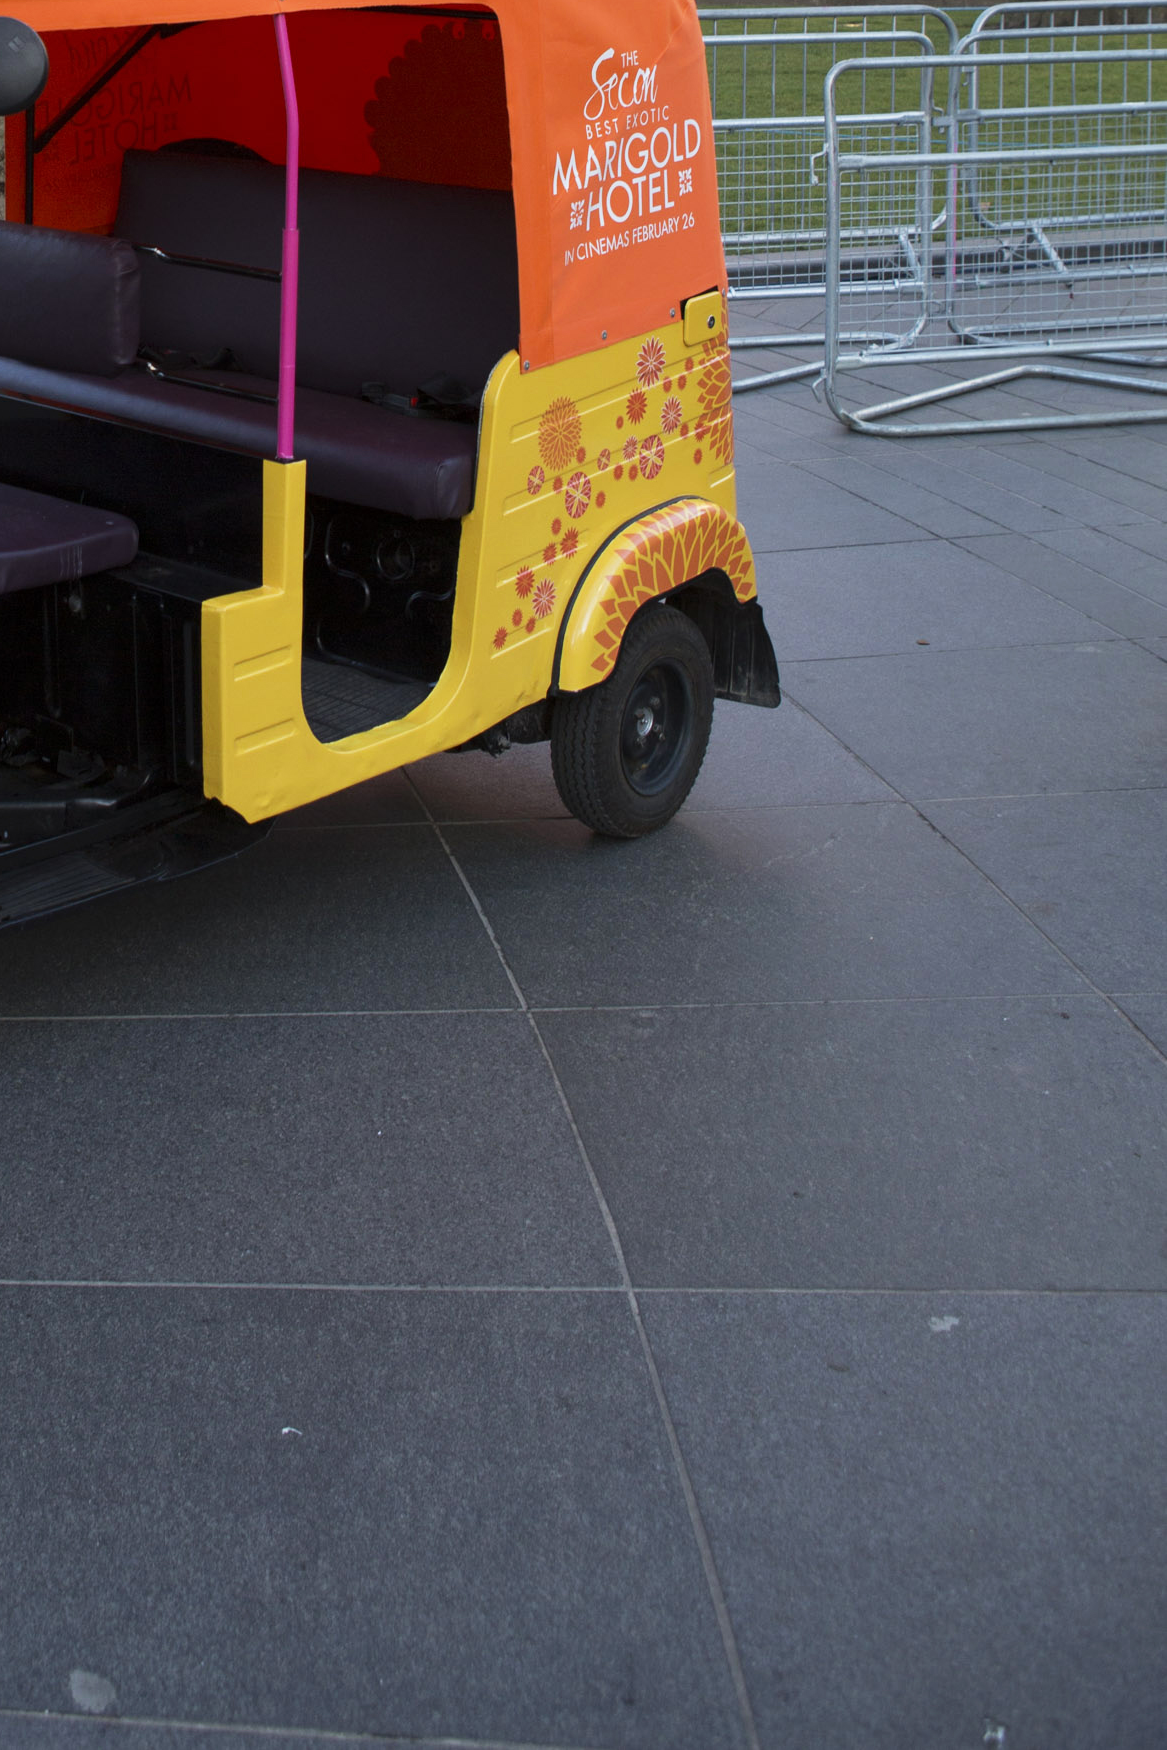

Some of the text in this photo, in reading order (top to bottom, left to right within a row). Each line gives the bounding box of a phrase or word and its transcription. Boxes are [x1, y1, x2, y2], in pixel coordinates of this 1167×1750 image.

[620, 50, 639, 69] THE
[585, 105, 670, 139] BEST EXOTIC
[552, 118, 701, 195] MARIGOLD
[586, 169, 675, 231] HOTEL
[564, 212, 695, 266] IN CINEMAS FEBRUARY 26
